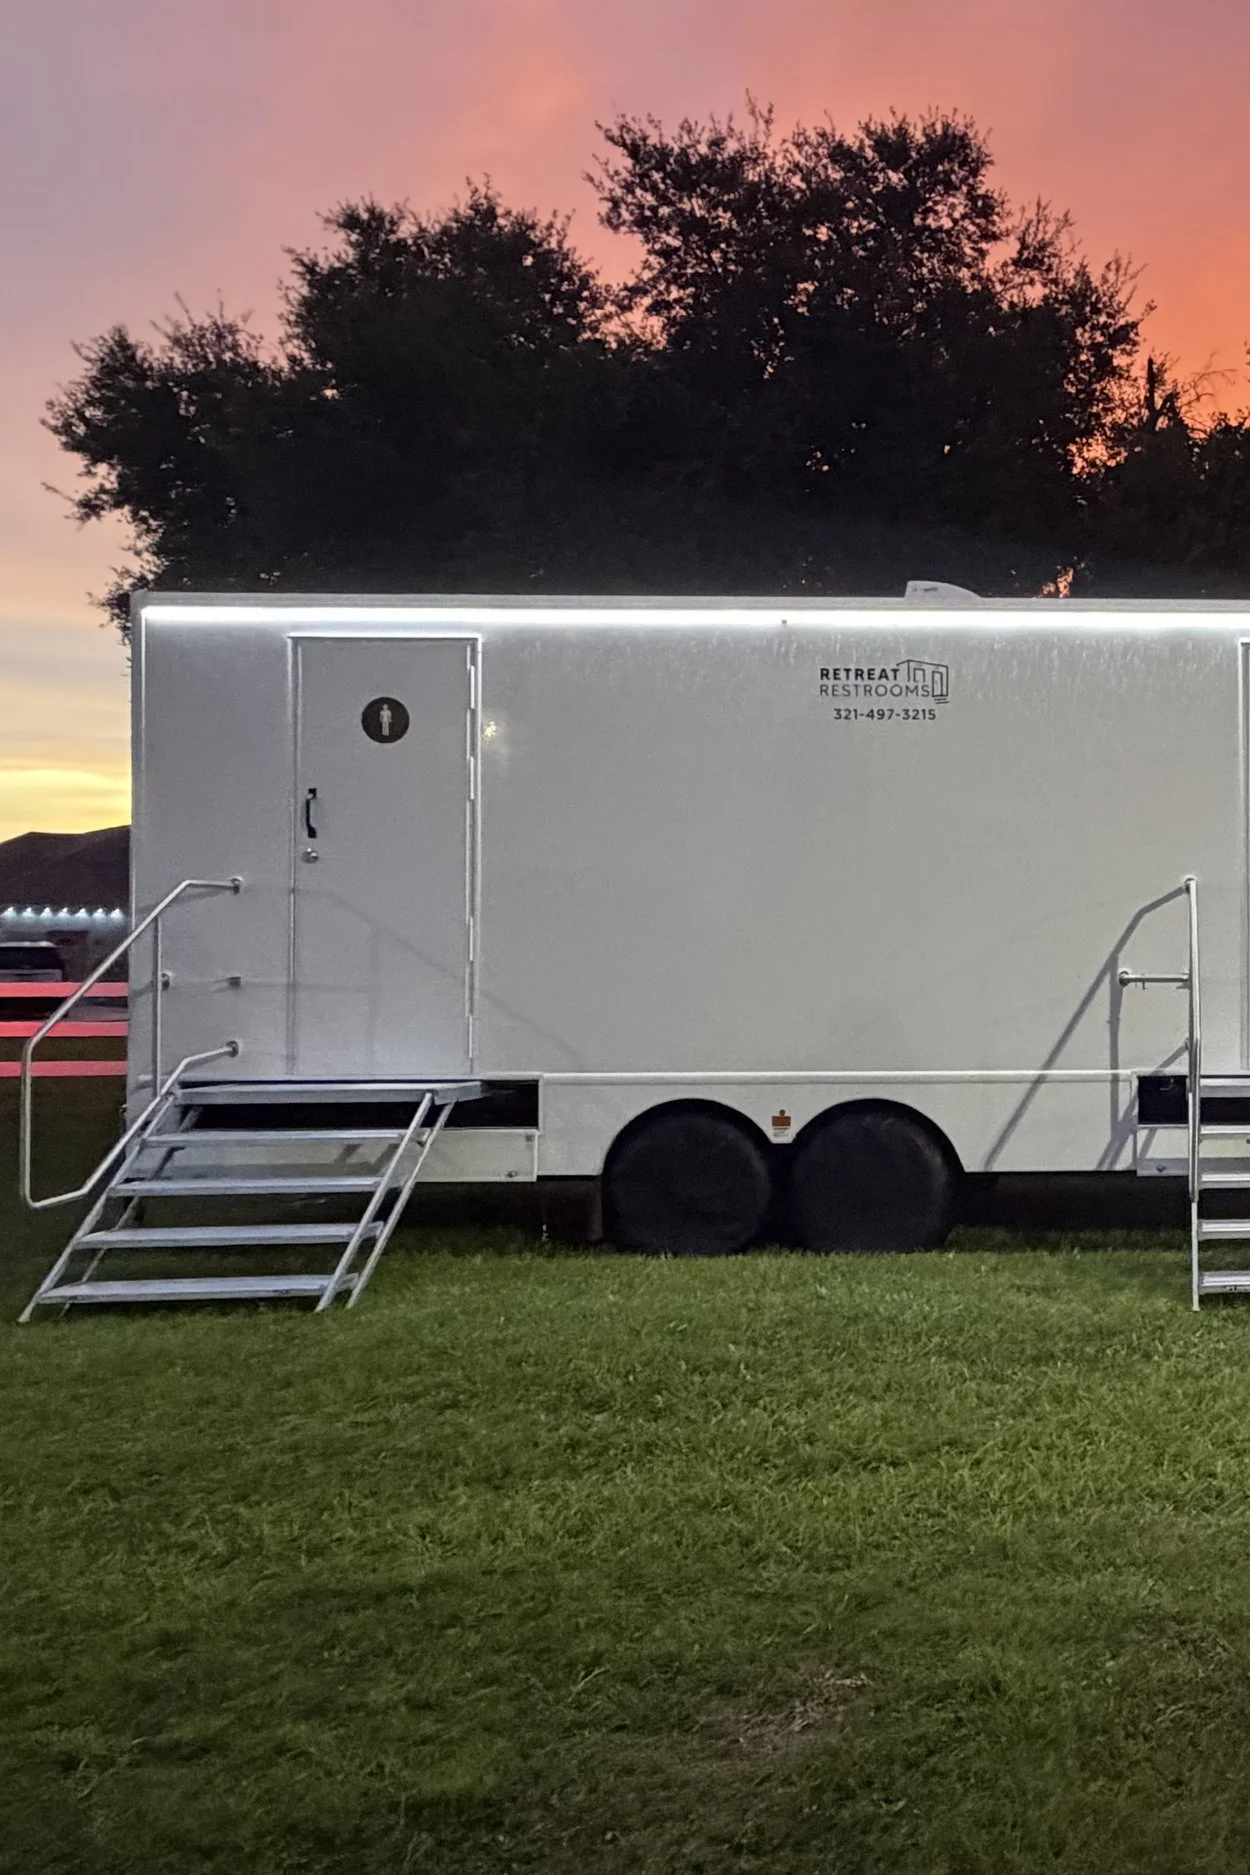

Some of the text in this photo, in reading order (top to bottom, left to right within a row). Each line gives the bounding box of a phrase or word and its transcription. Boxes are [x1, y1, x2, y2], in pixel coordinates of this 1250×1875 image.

[820, 668, 899, 681] RETREAT
[820, 684, 930, 697] RESTROOMS
[834, 708, 936, 720] 321-497-3215
